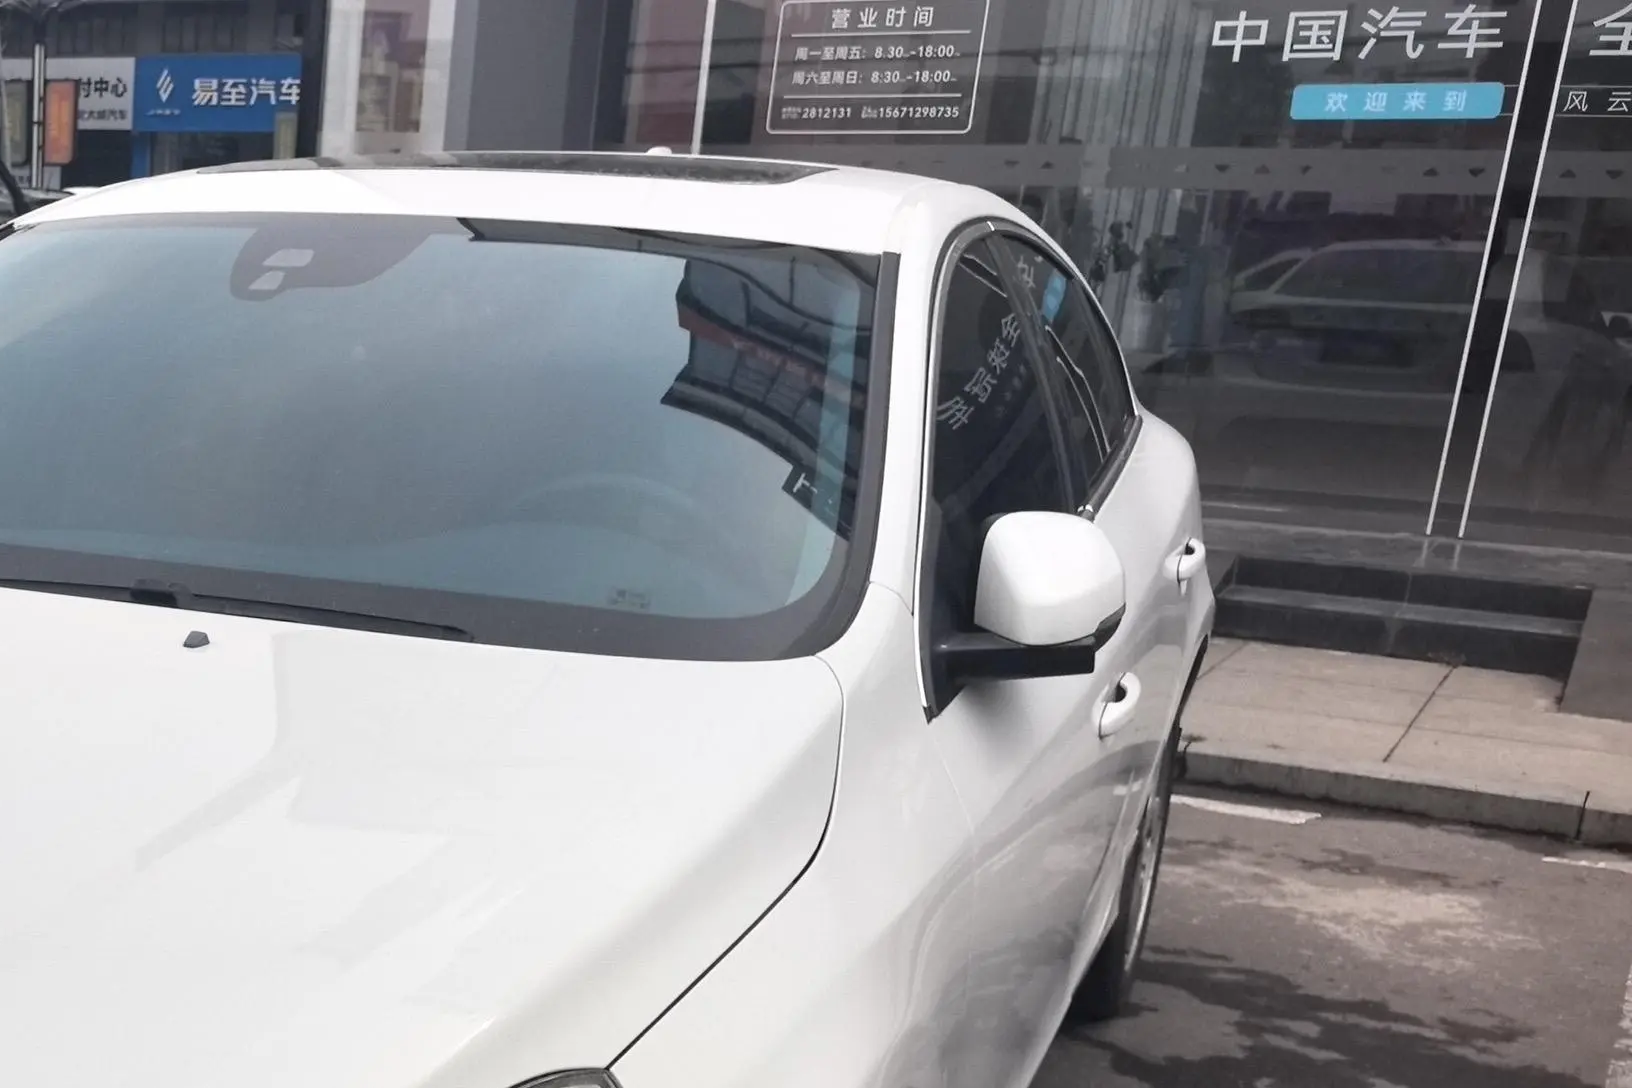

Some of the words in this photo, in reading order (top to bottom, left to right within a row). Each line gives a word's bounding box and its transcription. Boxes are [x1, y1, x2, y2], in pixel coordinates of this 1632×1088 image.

[831, 6, 934, 29] 营业时间
[1211, 4, 1508, 63] 中国汽车
[191, 77, 301, 106] 易至汽车
[1325, 91, 1466, 112] 欢迎来到
[1563, 91, 1632, 112] 风云
[802, 107, 851, 119] 2812131
[878, 106, 959, 119] 15671298735
